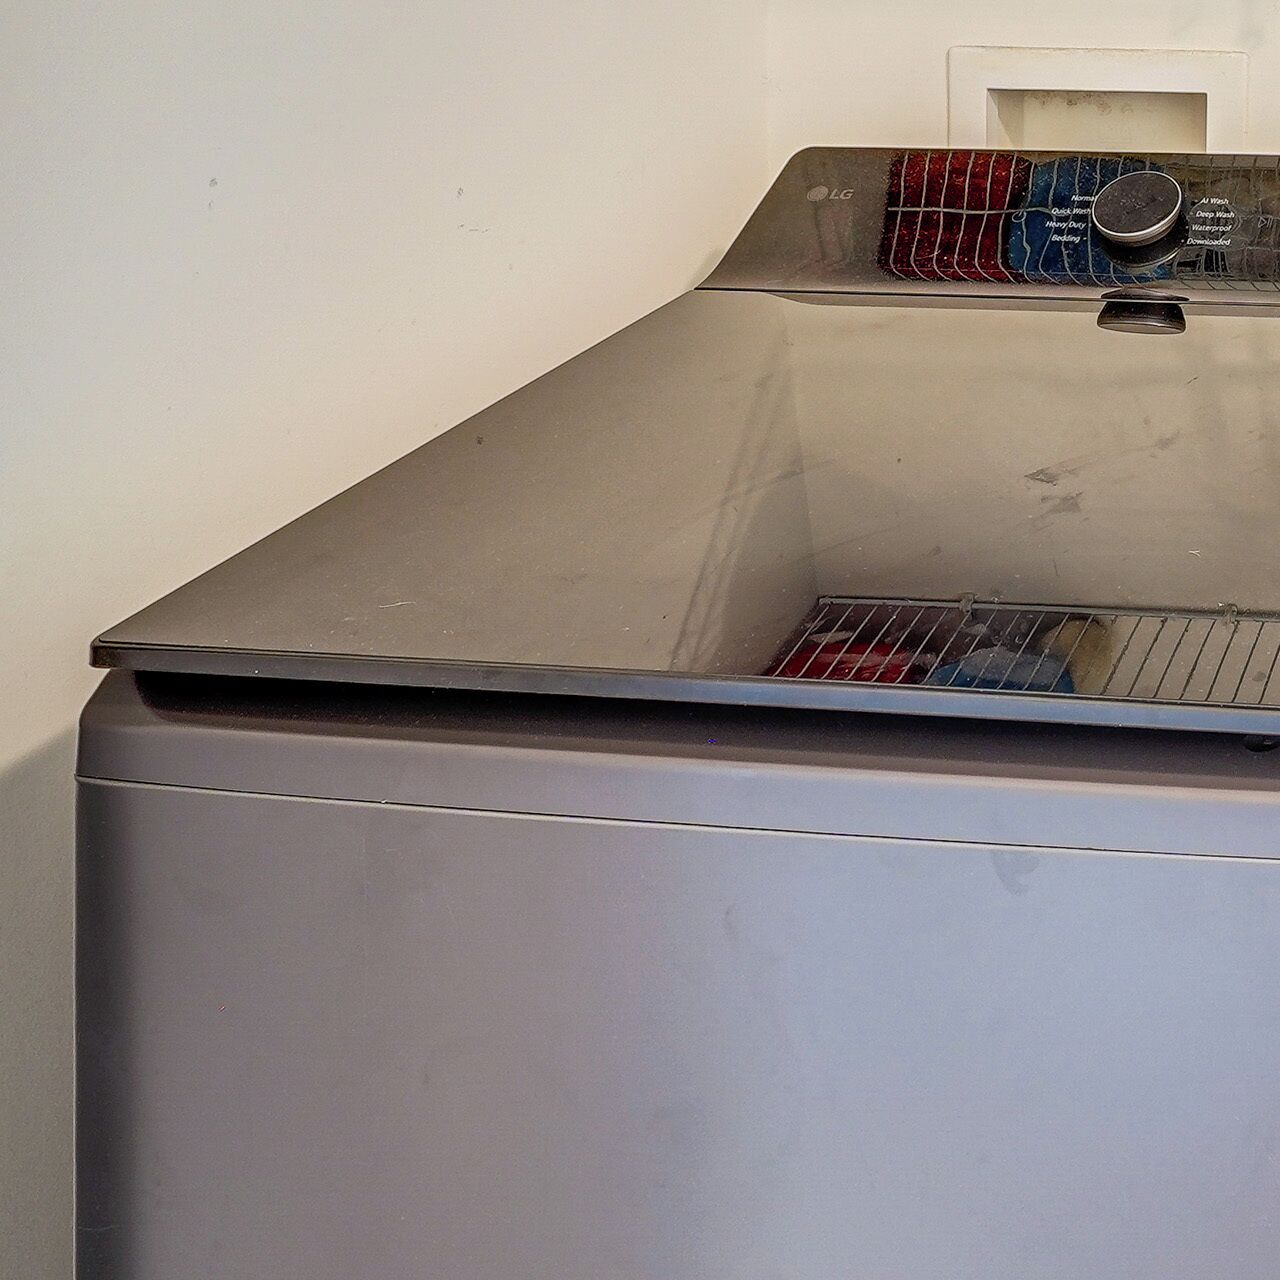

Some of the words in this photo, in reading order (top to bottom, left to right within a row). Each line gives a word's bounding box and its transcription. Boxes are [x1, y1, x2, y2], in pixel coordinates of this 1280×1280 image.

[829, 189, 854, 200] LG
[1046, 221, 1067, 229] Heavy
[1069, 221, 1086, 229] Duty
[1192, 224, 1232, 233] Waterproof
[1051, 235, 1080, 243] Bedding
[1187, 238, 1230, 246] Downloaded
